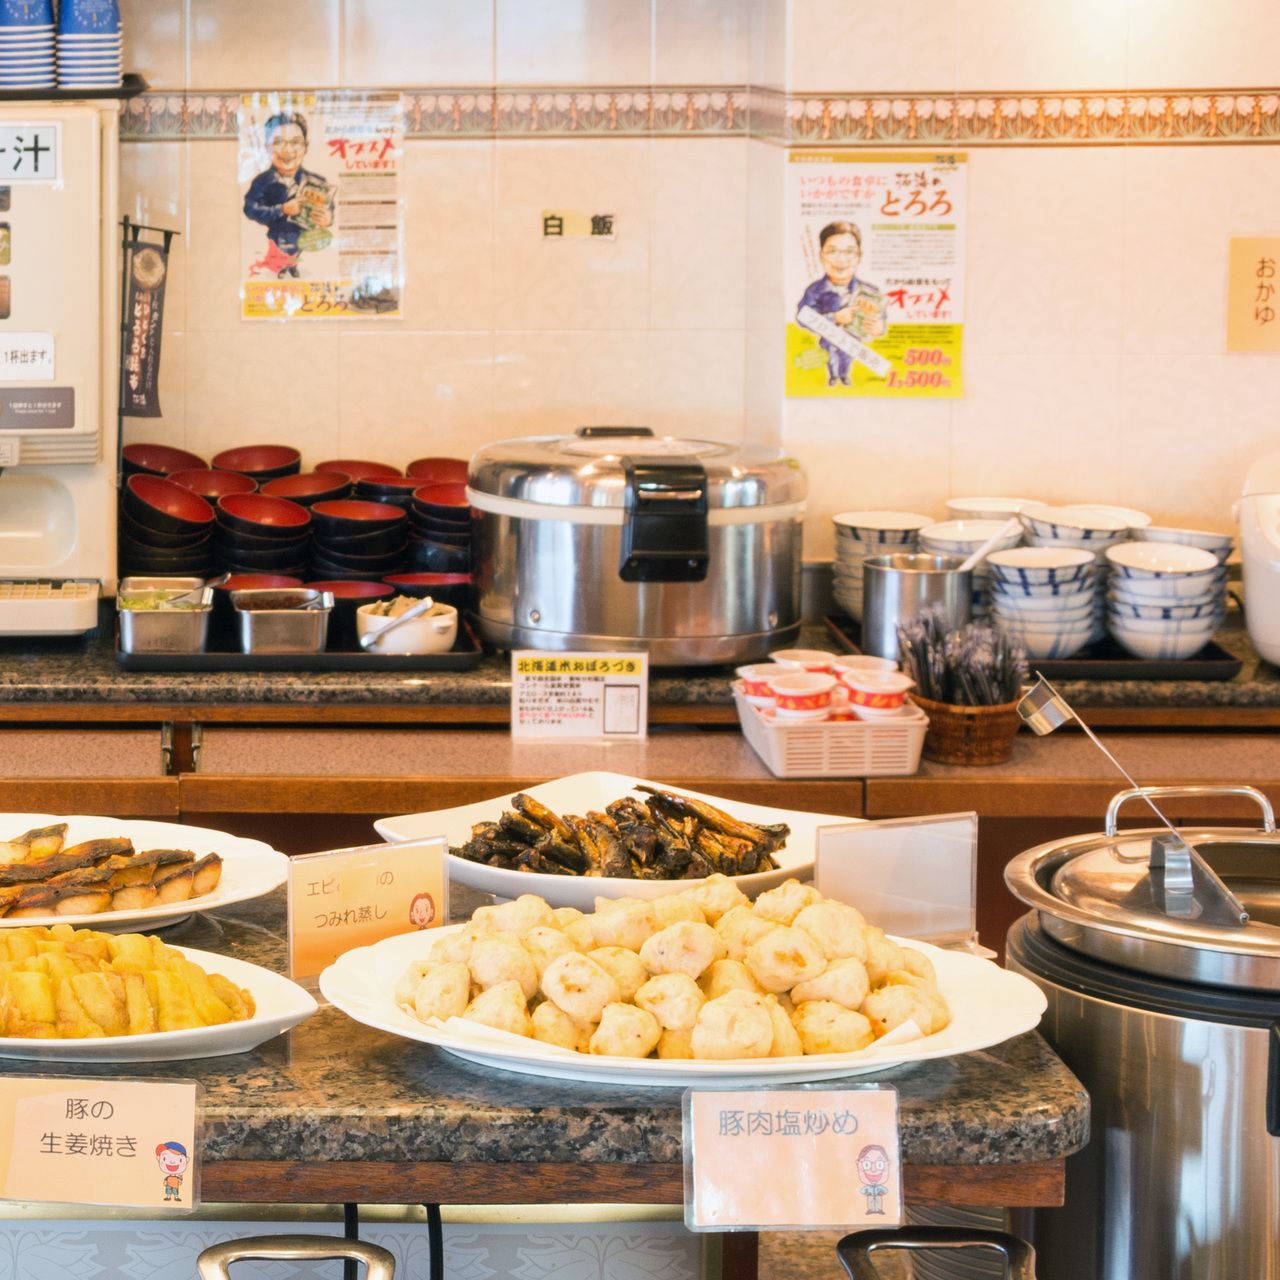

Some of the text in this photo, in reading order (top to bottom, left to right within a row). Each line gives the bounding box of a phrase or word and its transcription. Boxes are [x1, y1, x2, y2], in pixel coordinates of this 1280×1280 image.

[879, 189, 954, 217] とろろ
[300, 294, 350, 313] とろろ
[1254, 256, 1277, 326] おかゆ
[517, 660, 637, 673] 北海道米おぼろづき
[314, 904, 389, 929] つみれ蒸し
[65, 1097, 115, 1121] 豚の
[717, 1108, 860, 1137] 豚肉塩炒め
[39, 1132, 138, 1158] 生姜焼き
